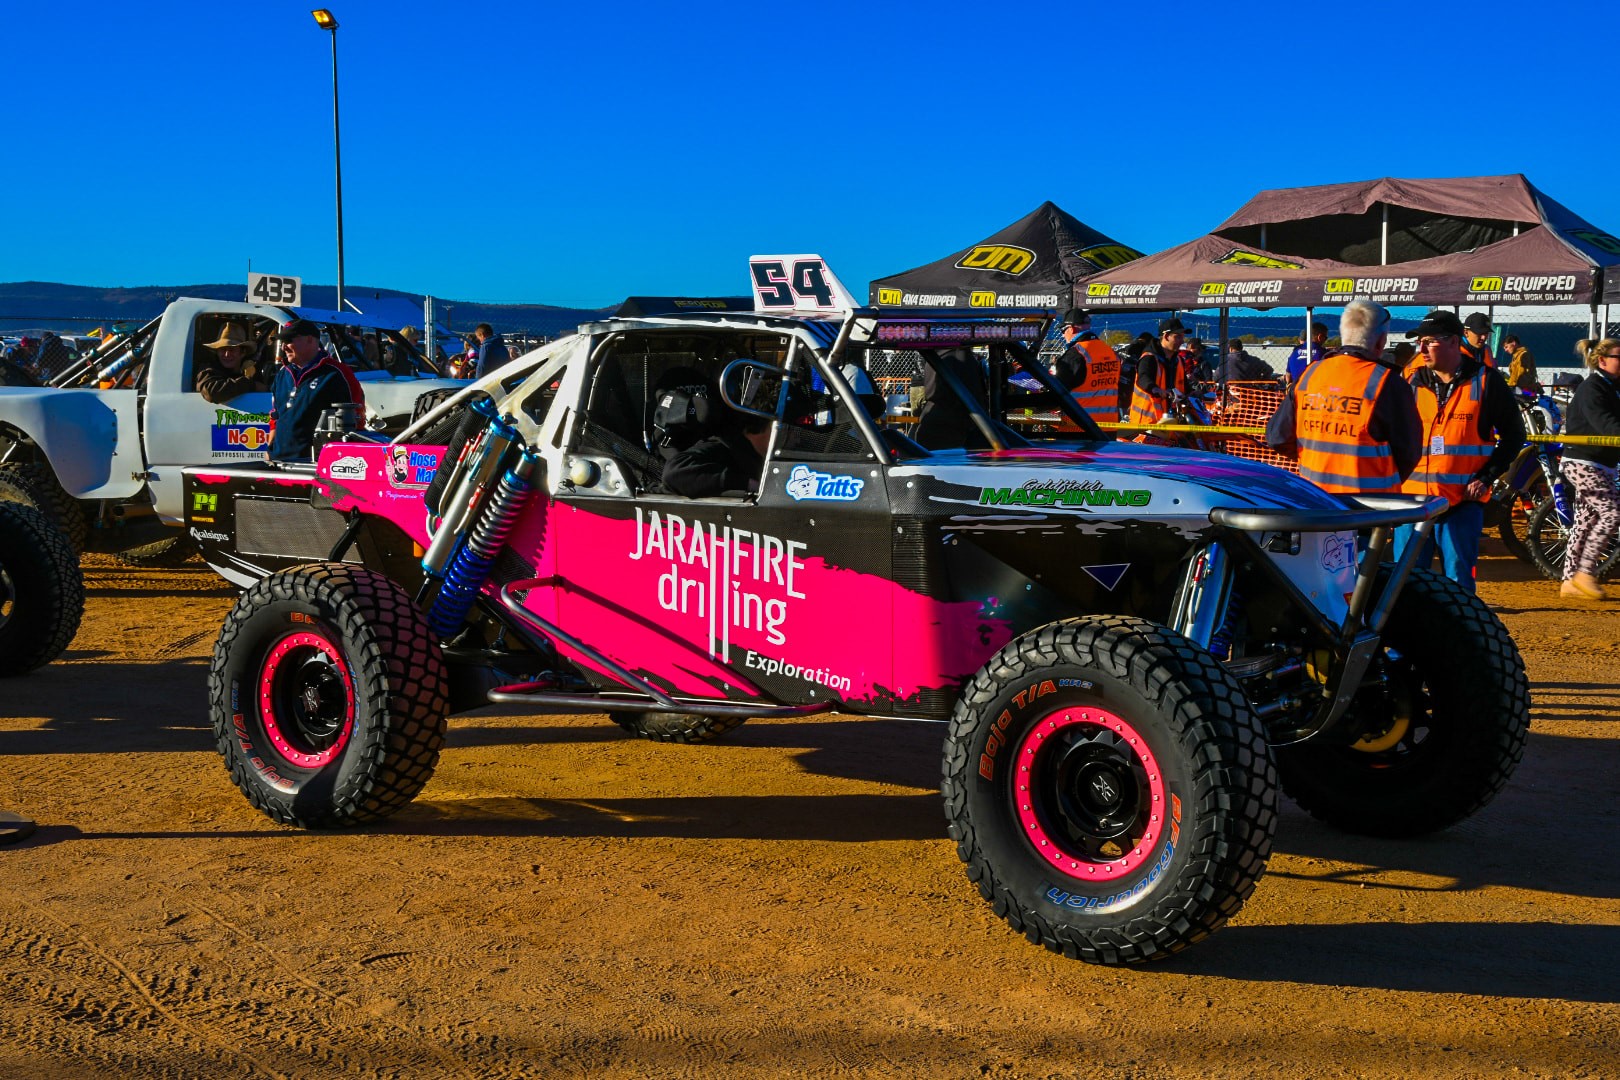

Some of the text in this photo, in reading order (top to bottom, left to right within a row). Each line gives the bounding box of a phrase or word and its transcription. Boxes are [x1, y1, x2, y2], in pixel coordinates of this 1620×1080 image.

[253, 276, 297, 304] 433
[750, 260, 835, 308] 54
[1110, 284, 1161, 297] EQUIPPED
[1227, 280, 1283, 295] EQUIPPED
[1355, 278, 1419, 294] EQUIPPED
[1504, 276, 1576, 292] EQUIPPED
[919, 294, 956, 306] EQUIPPED
[1016, 295, 1058, 307] EQUIPPED
[1091, 376, 1118, 387] OFFICIA
[1304, 420, 1357, 437] OFFICIAL
[409, 451, 437, 468] Hose
[331, 465, 360, 475] cams
[816, 477, 859, 497] Tatts
[1023, 479, 1104, 494] Goldfields
[979, 488, 1152, 507] MACHINING
[629, 507, 808, 600] JARAHFIRE
[658, 563, 787, 664] drilling
[745, 651, 851, 690] Exploration
[233, 713, 254, 754] T/A
[978, 709, 1013, 782] Baja
[1012, 679, 1057, 710] T/A
[250, 756, 294, 791] Baja
